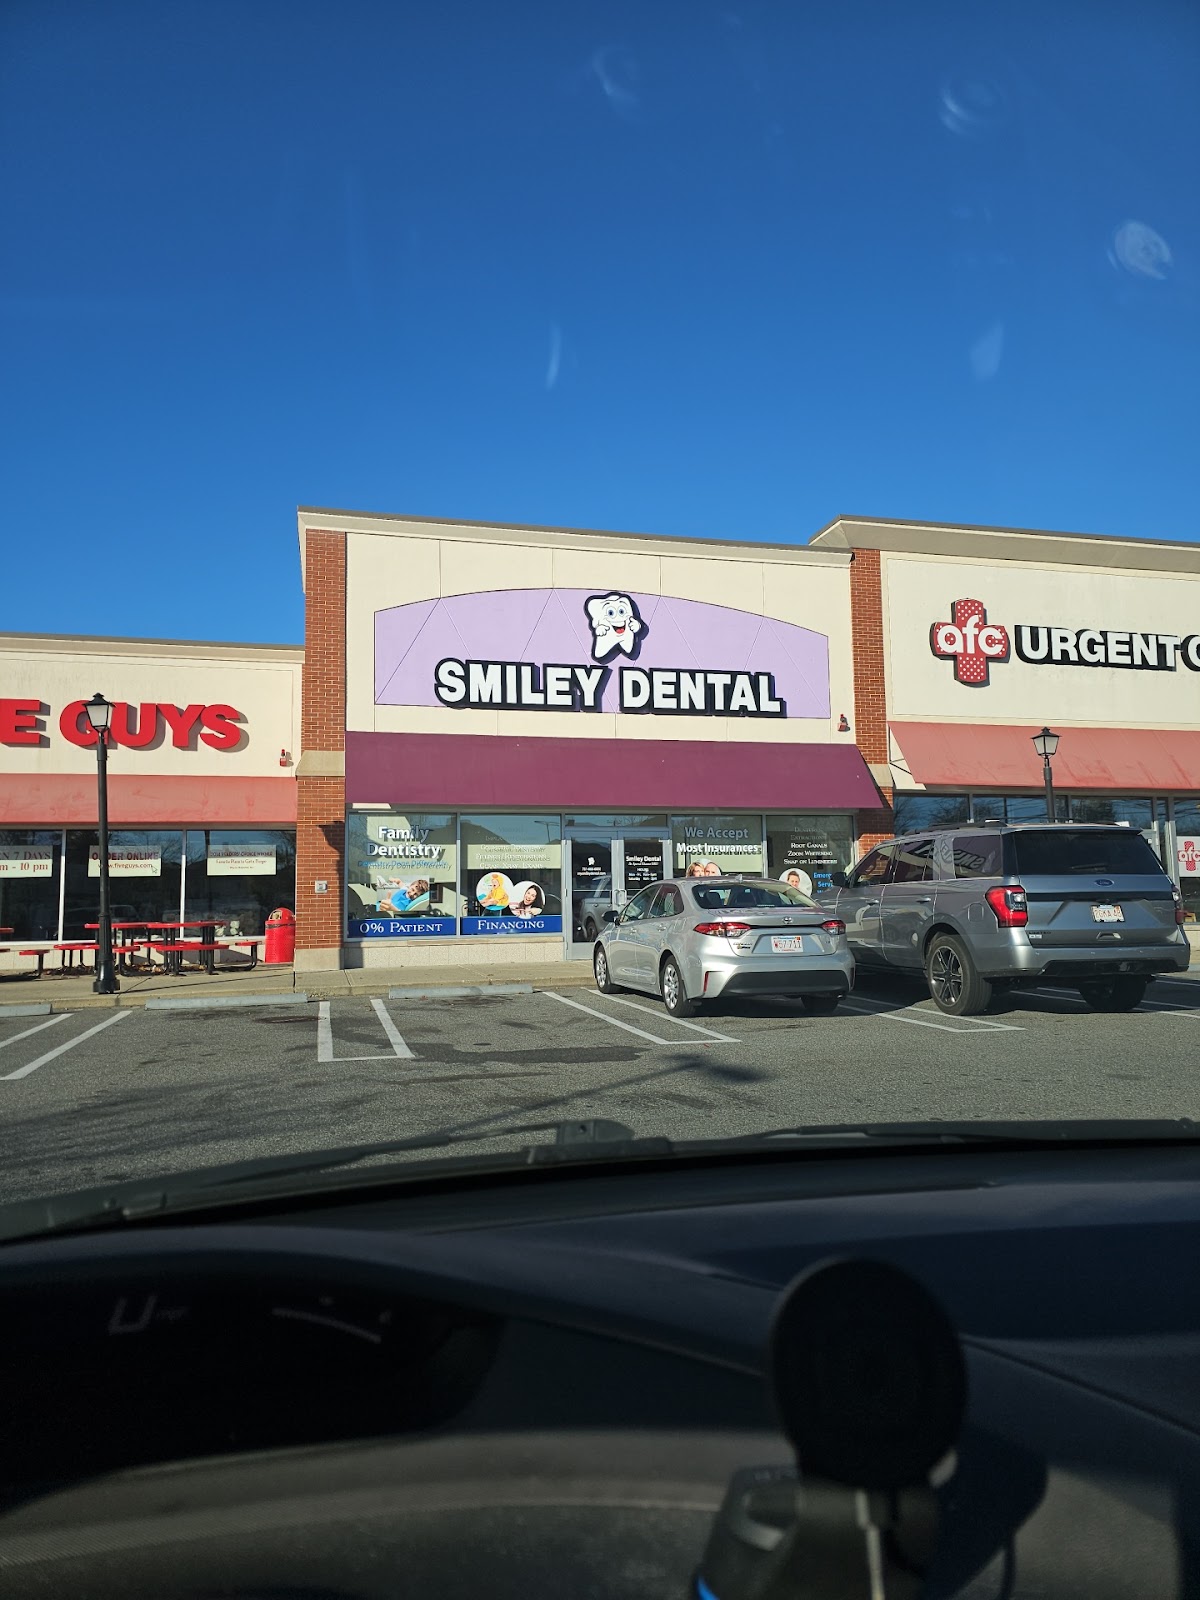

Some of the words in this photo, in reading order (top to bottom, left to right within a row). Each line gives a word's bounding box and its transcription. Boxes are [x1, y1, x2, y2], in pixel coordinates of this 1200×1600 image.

[936, 614, 1005, 655] afc
[1016, 624, 1181, 670] URGENT
[435, 659, 609, 711] SMILEY
[619, 667, 785, 718] DENTAL
[60, 700, 243, 750] GUYS
[378, 825, 429, 843] Family
[684, 826, 704, 838] We
[706, 827, 749, 841] Accept
[367, 842, 441, 859] Dentistry
[676, 842, 703, 853] Most
[704, 842, 758, 853] Insurances
[13, 851, 20, 860] 7
[24, 850, 51, 860] DAYS
[91, 850, 124, 861] ODER
[126, 850, 160, 861] ONLINE
[625, 855, 643, 863] Smiley
[32, 863, 49, 873] pm
[97, 862, 153, 871] w.fiveguys.com
[359, 922, 385, 934] 0%
[389, 921, 443, 934] PATIENT
[477, 918, 545, 931] FINANCING
